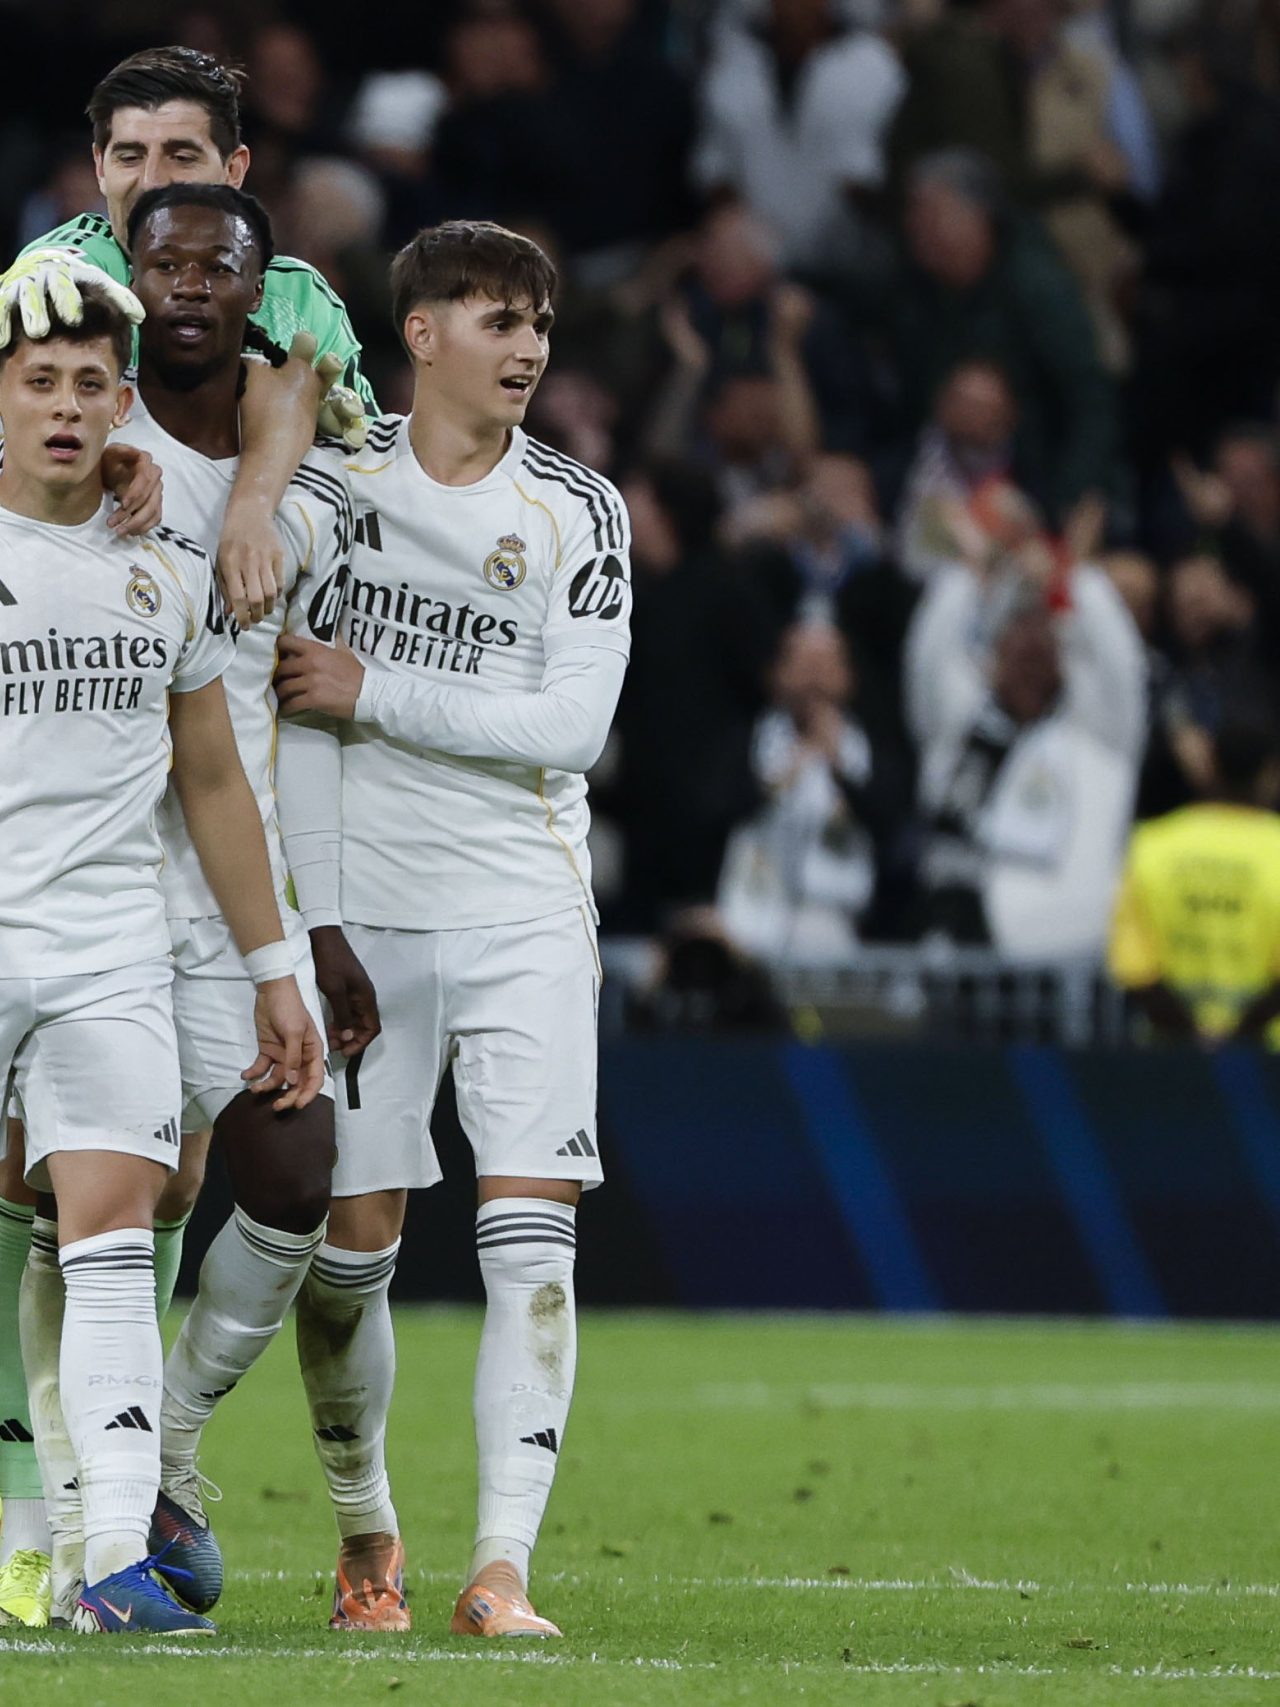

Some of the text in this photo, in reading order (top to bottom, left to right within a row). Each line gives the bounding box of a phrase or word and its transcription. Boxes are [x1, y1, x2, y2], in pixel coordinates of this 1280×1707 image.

[308, 564, 350, 642] h
[343, 572, 518, 647] mirates
[568, 554, 629, 620] hp
[348, 617, 484, 675] FLY BETTER
[3, 677, 143, 716] FLY BETTER
